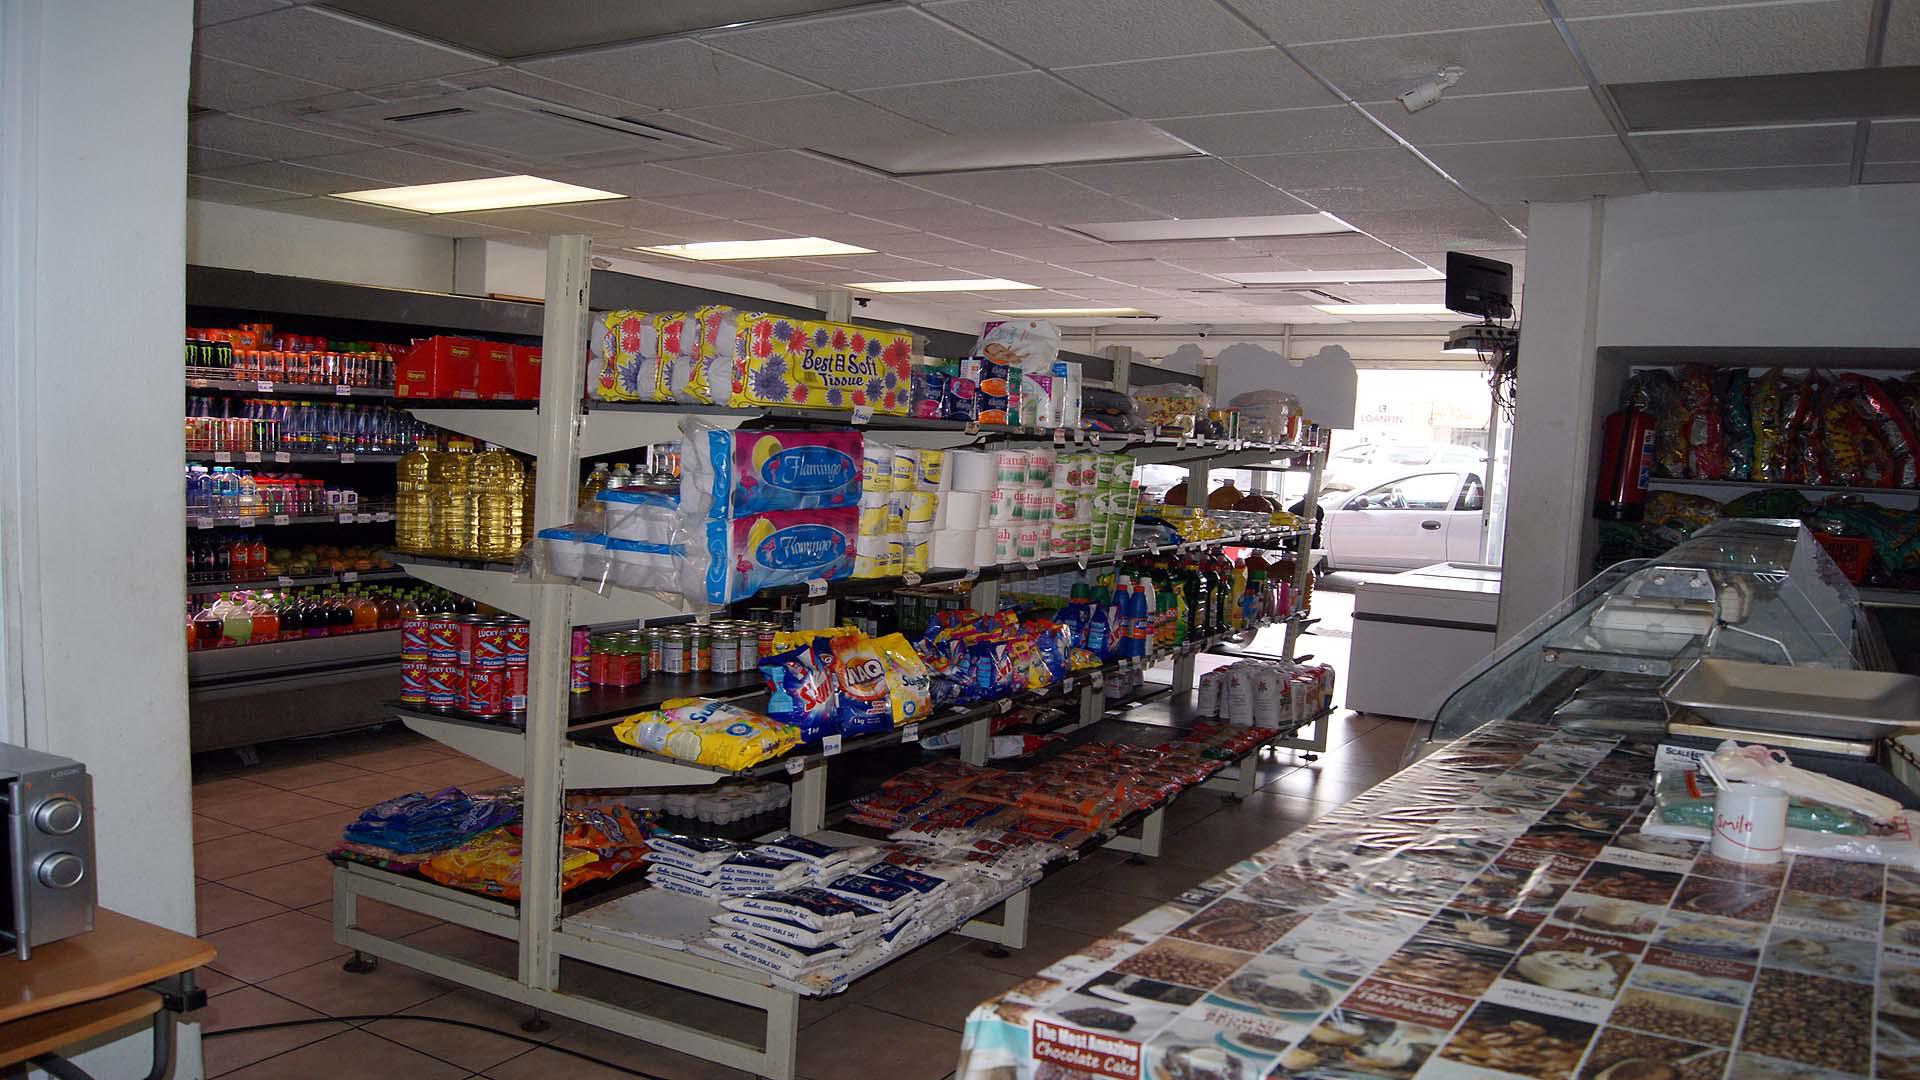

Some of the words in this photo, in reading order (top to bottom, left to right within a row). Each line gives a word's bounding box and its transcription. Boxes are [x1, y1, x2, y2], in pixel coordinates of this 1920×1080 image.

[802, 348, 833, 373] Best
[847, 353, 878, 376] Soft
[817, 372, 865, 387] Tissue
[782, 454, 844, 485] Flamingo
[770, 535, 832, 565] Flamingo
[846, 657, 884, 687] MAQ
[783, 907, 798, 915] TABLE
[772, 927, 786, 935] TABLE
[787, 931, 800, 939] SALT
[757, 957, 771, 967] TABLE
[771, 963, 782, 971] SALT
[767, 945, 781, 955] TABLE
[781, 951, 792, 959] SALT
[1036, 1022, 1058, 1042] The
[1058, 1028, 1088, 1050] Most
[1088, 1034, 1139, 1062] Amazing
[1035, 1040, 1101, 1069] Chocolate
[1103, 1056, 1138, 1077] Cake
